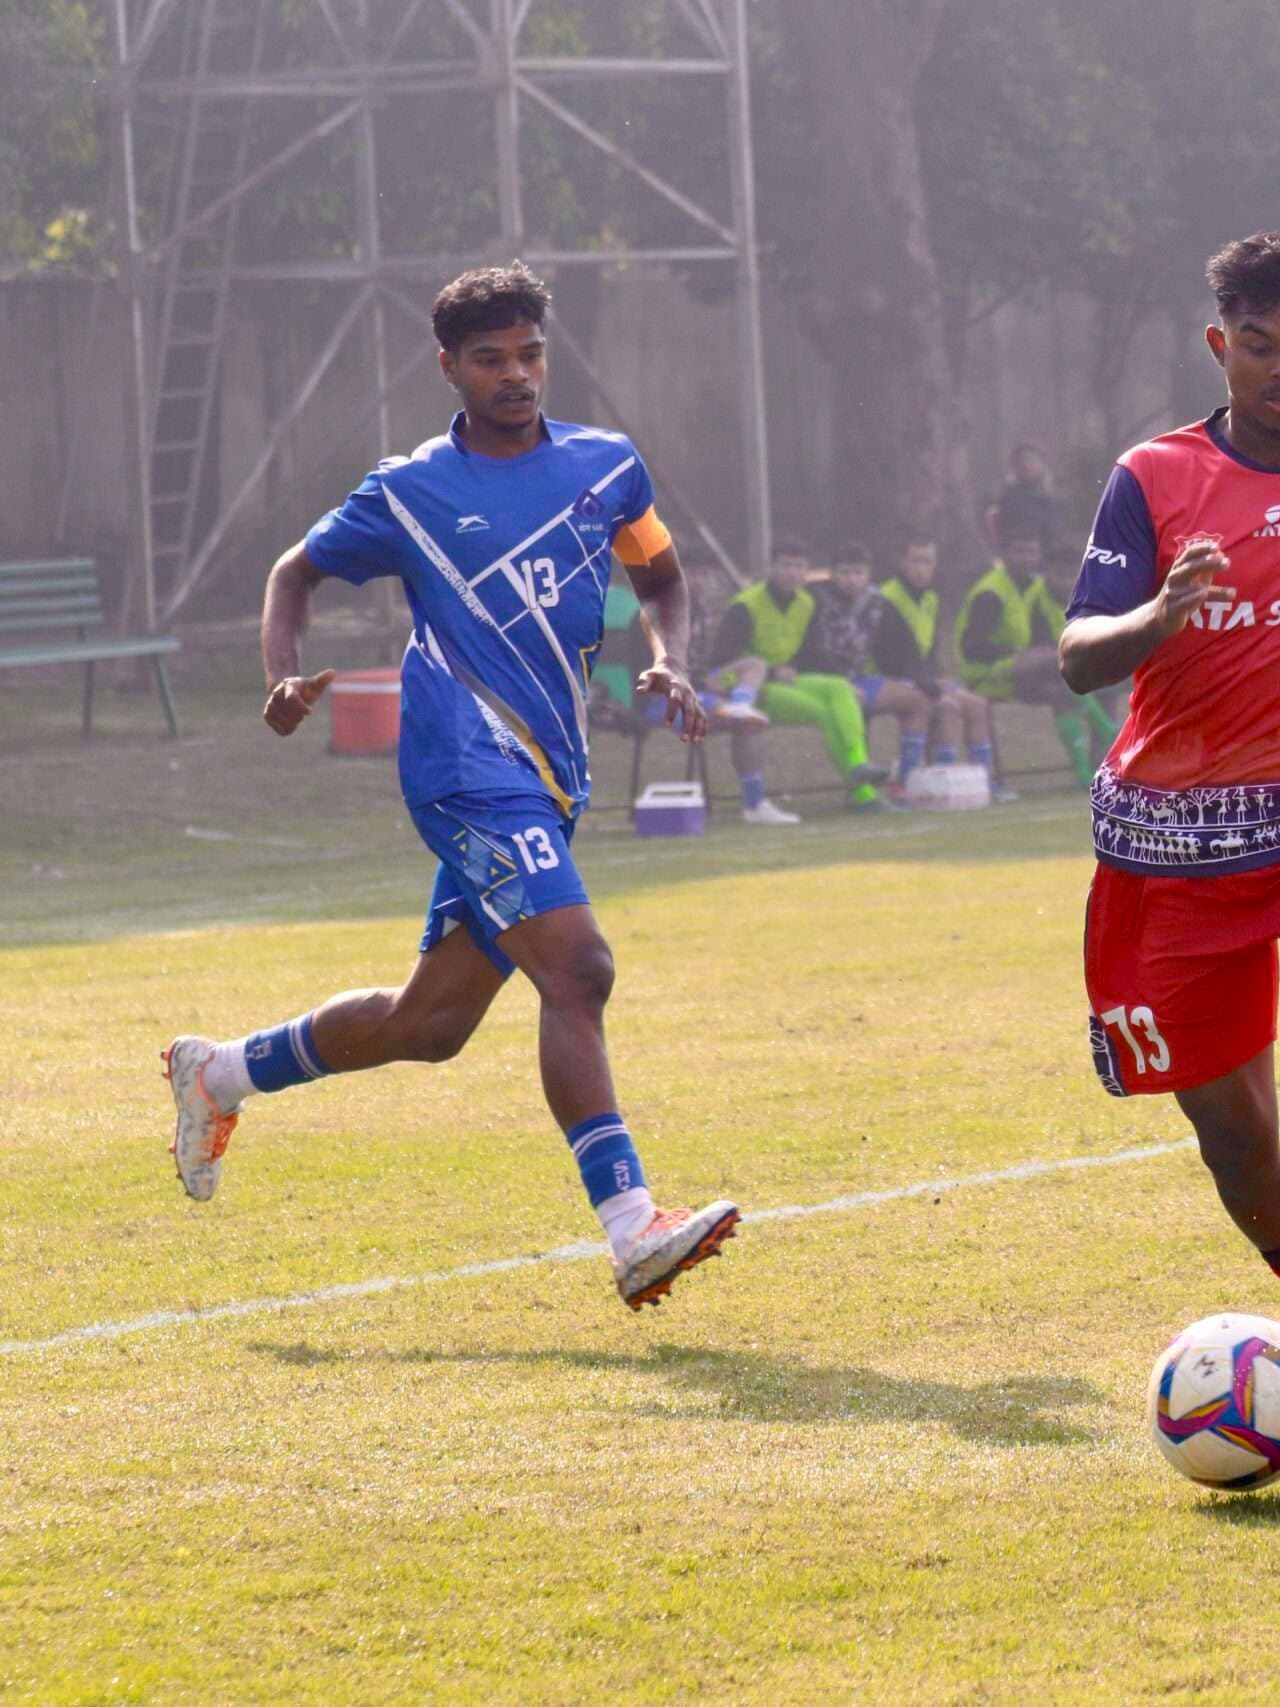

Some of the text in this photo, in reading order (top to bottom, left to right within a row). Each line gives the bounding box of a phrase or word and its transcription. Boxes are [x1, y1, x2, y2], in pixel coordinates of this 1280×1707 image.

[521, 557, 560, 610] 13
[511, 826, 560, 875] 13
[1101, 1005, 1170, 1075] 73
